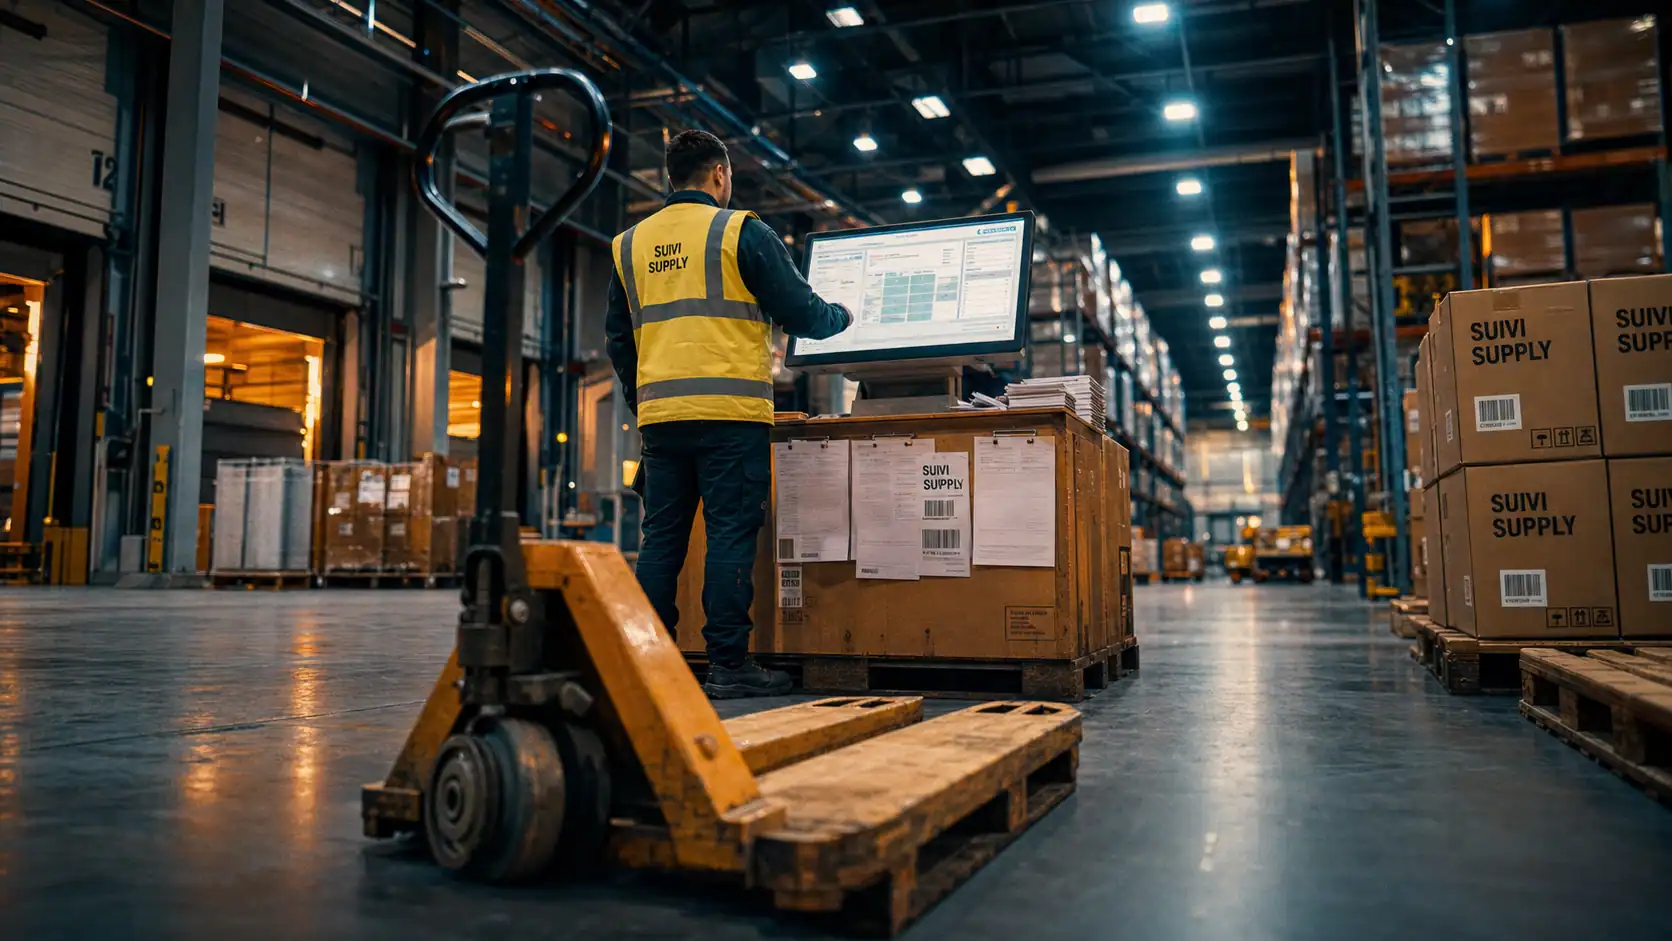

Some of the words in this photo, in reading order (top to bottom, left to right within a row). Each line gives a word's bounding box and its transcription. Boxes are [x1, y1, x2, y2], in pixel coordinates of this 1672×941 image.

[654, 242, 682, 258] SUIVI
[648, 255, 689, 274] SUPPLY
[1470, 318, 1526, 341] SUIVI
[1471, 340, 1552, 366] SUPPLY
[922, 464, 950, 476] SUIVI
[923, 478, 964, 491] SUPPLY
[1490, 491, 1548, 513] SUIVI
[1492, 515, 1576, 538] SUPPLY
